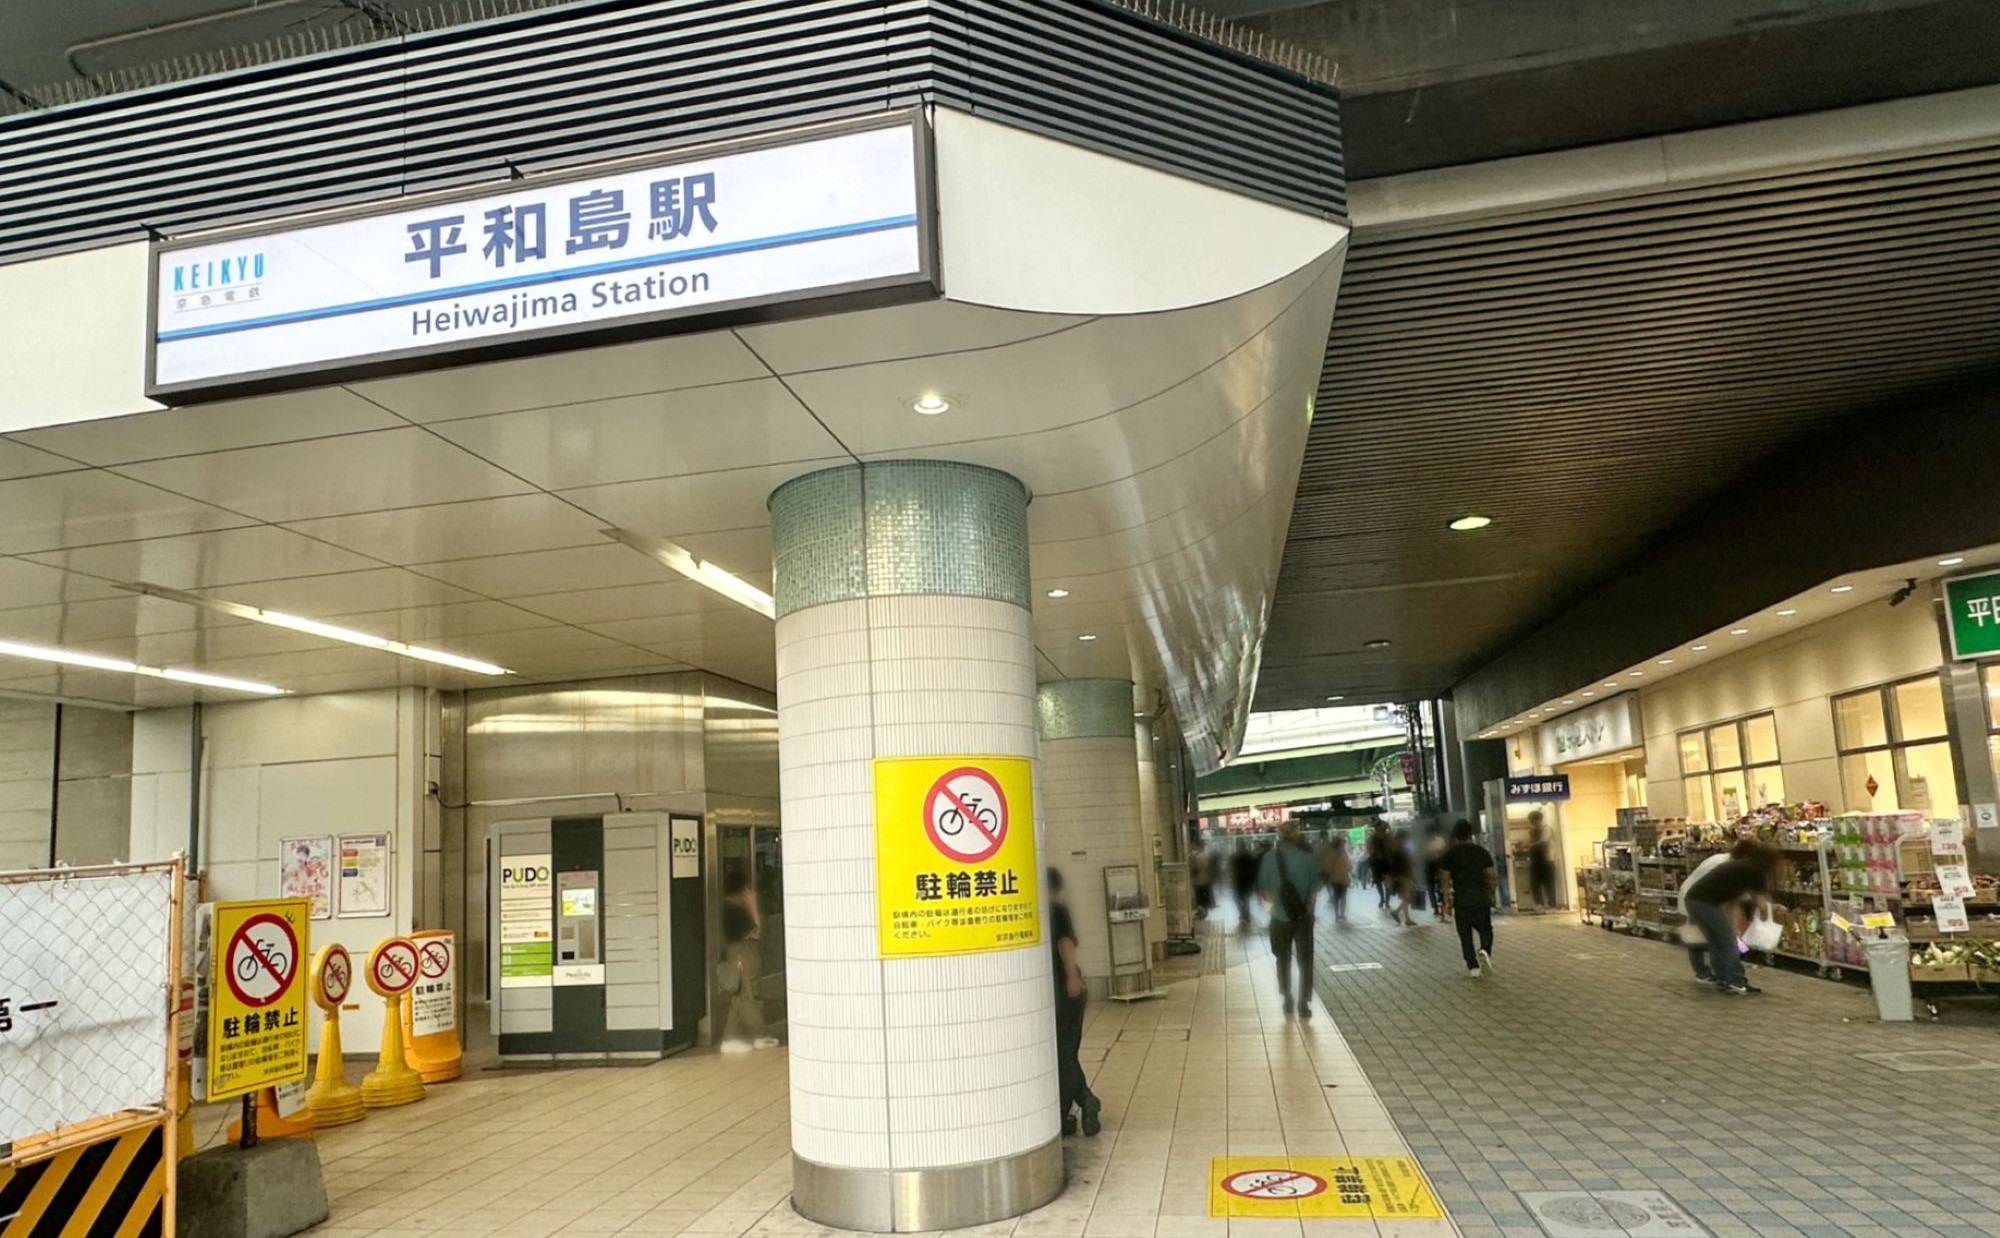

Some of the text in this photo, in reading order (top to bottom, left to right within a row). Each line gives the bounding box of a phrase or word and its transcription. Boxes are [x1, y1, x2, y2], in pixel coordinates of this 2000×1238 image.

[404, 172, 718, 279] 平和島駅
[174, 253, 264, 291] KEIKYU
[412, 271, 710, 336] Heiwajima Station
[1510, 782, 1563, 795] みずほ銀行
[674, 838, 697, 853] PUDO
[502, 866, 550, 883] PUDO
[915, 868, 1019, 901] 駐輪禁止
[223, 1006, 299, 1039] 駐輪禁止
[1331, 1166, 1371, 1204] 駐輪禁止
